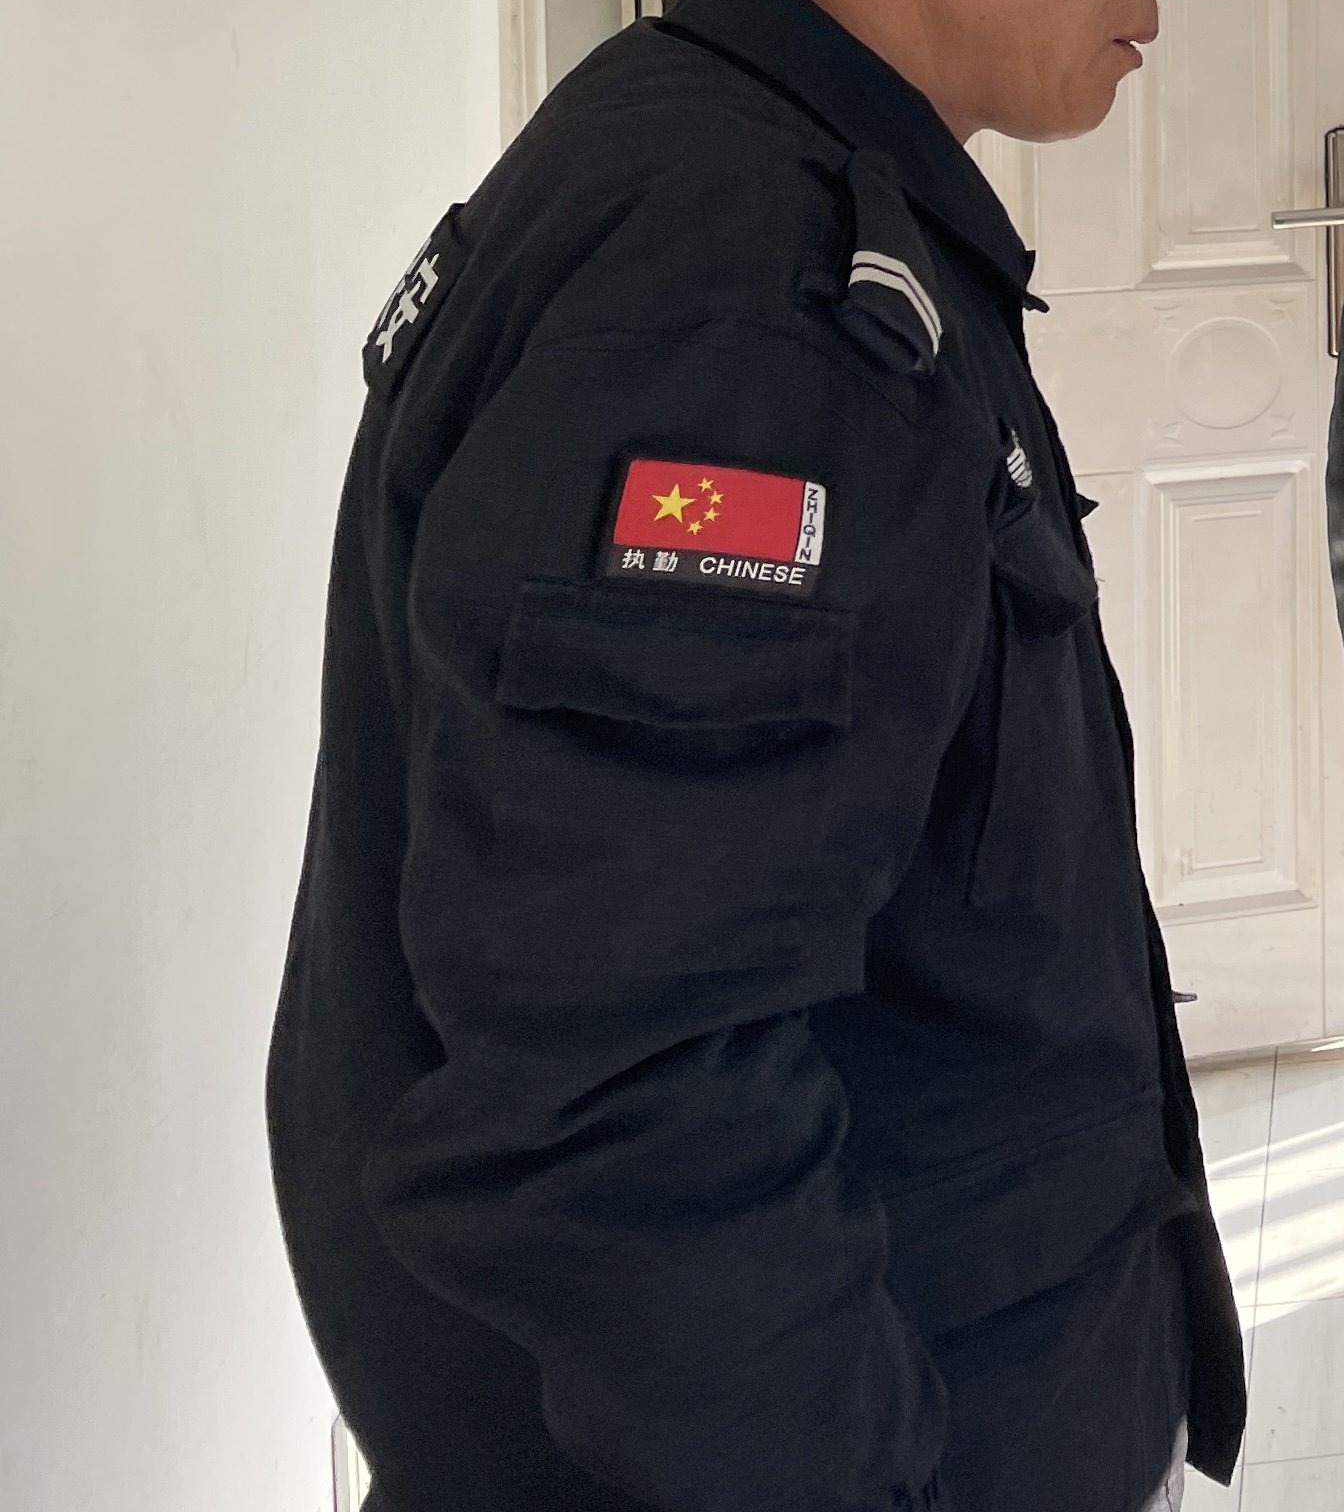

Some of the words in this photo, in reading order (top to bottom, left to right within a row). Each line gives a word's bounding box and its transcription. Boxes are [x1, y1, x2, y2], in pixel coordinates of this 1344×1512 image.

[801, 488, 818, 561] ZHIQIN
[621, 548, 678, 573] 执勤
[699, 556, 806, 585] CHINESE
